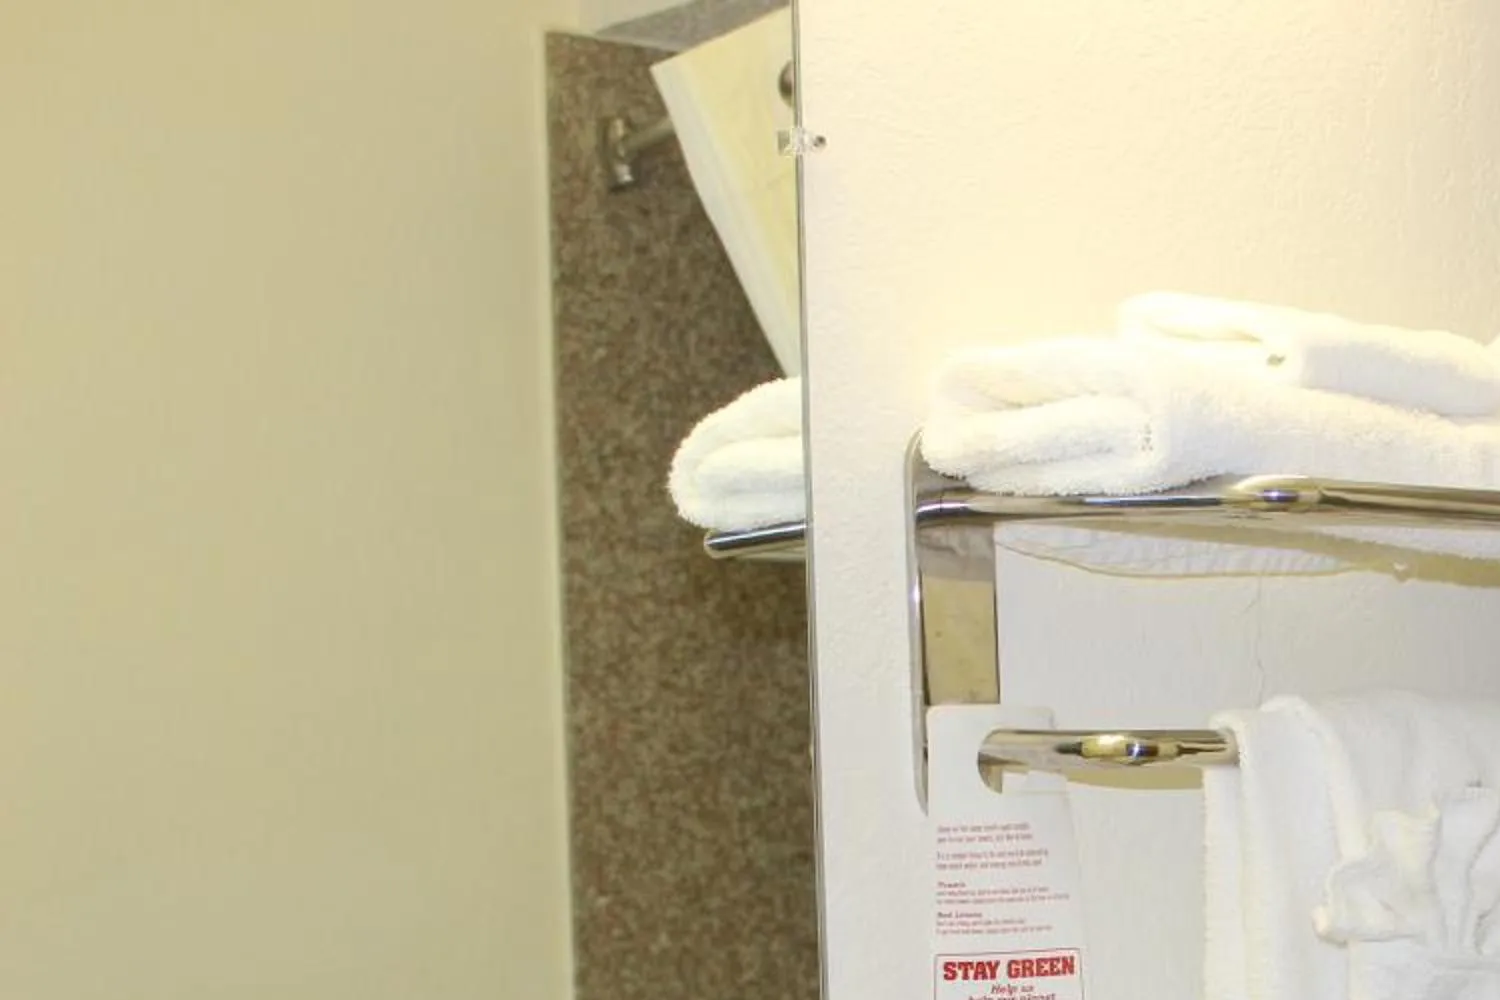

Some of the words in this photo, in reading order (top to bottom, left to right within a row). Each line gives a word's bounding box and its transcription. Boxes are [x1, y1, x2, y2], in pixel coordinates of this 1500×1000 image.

[943, 961, 1001, 981] STAY
[1007, 956, 1075, 979] GREEN
[991, 983, 1018, 995] Help
